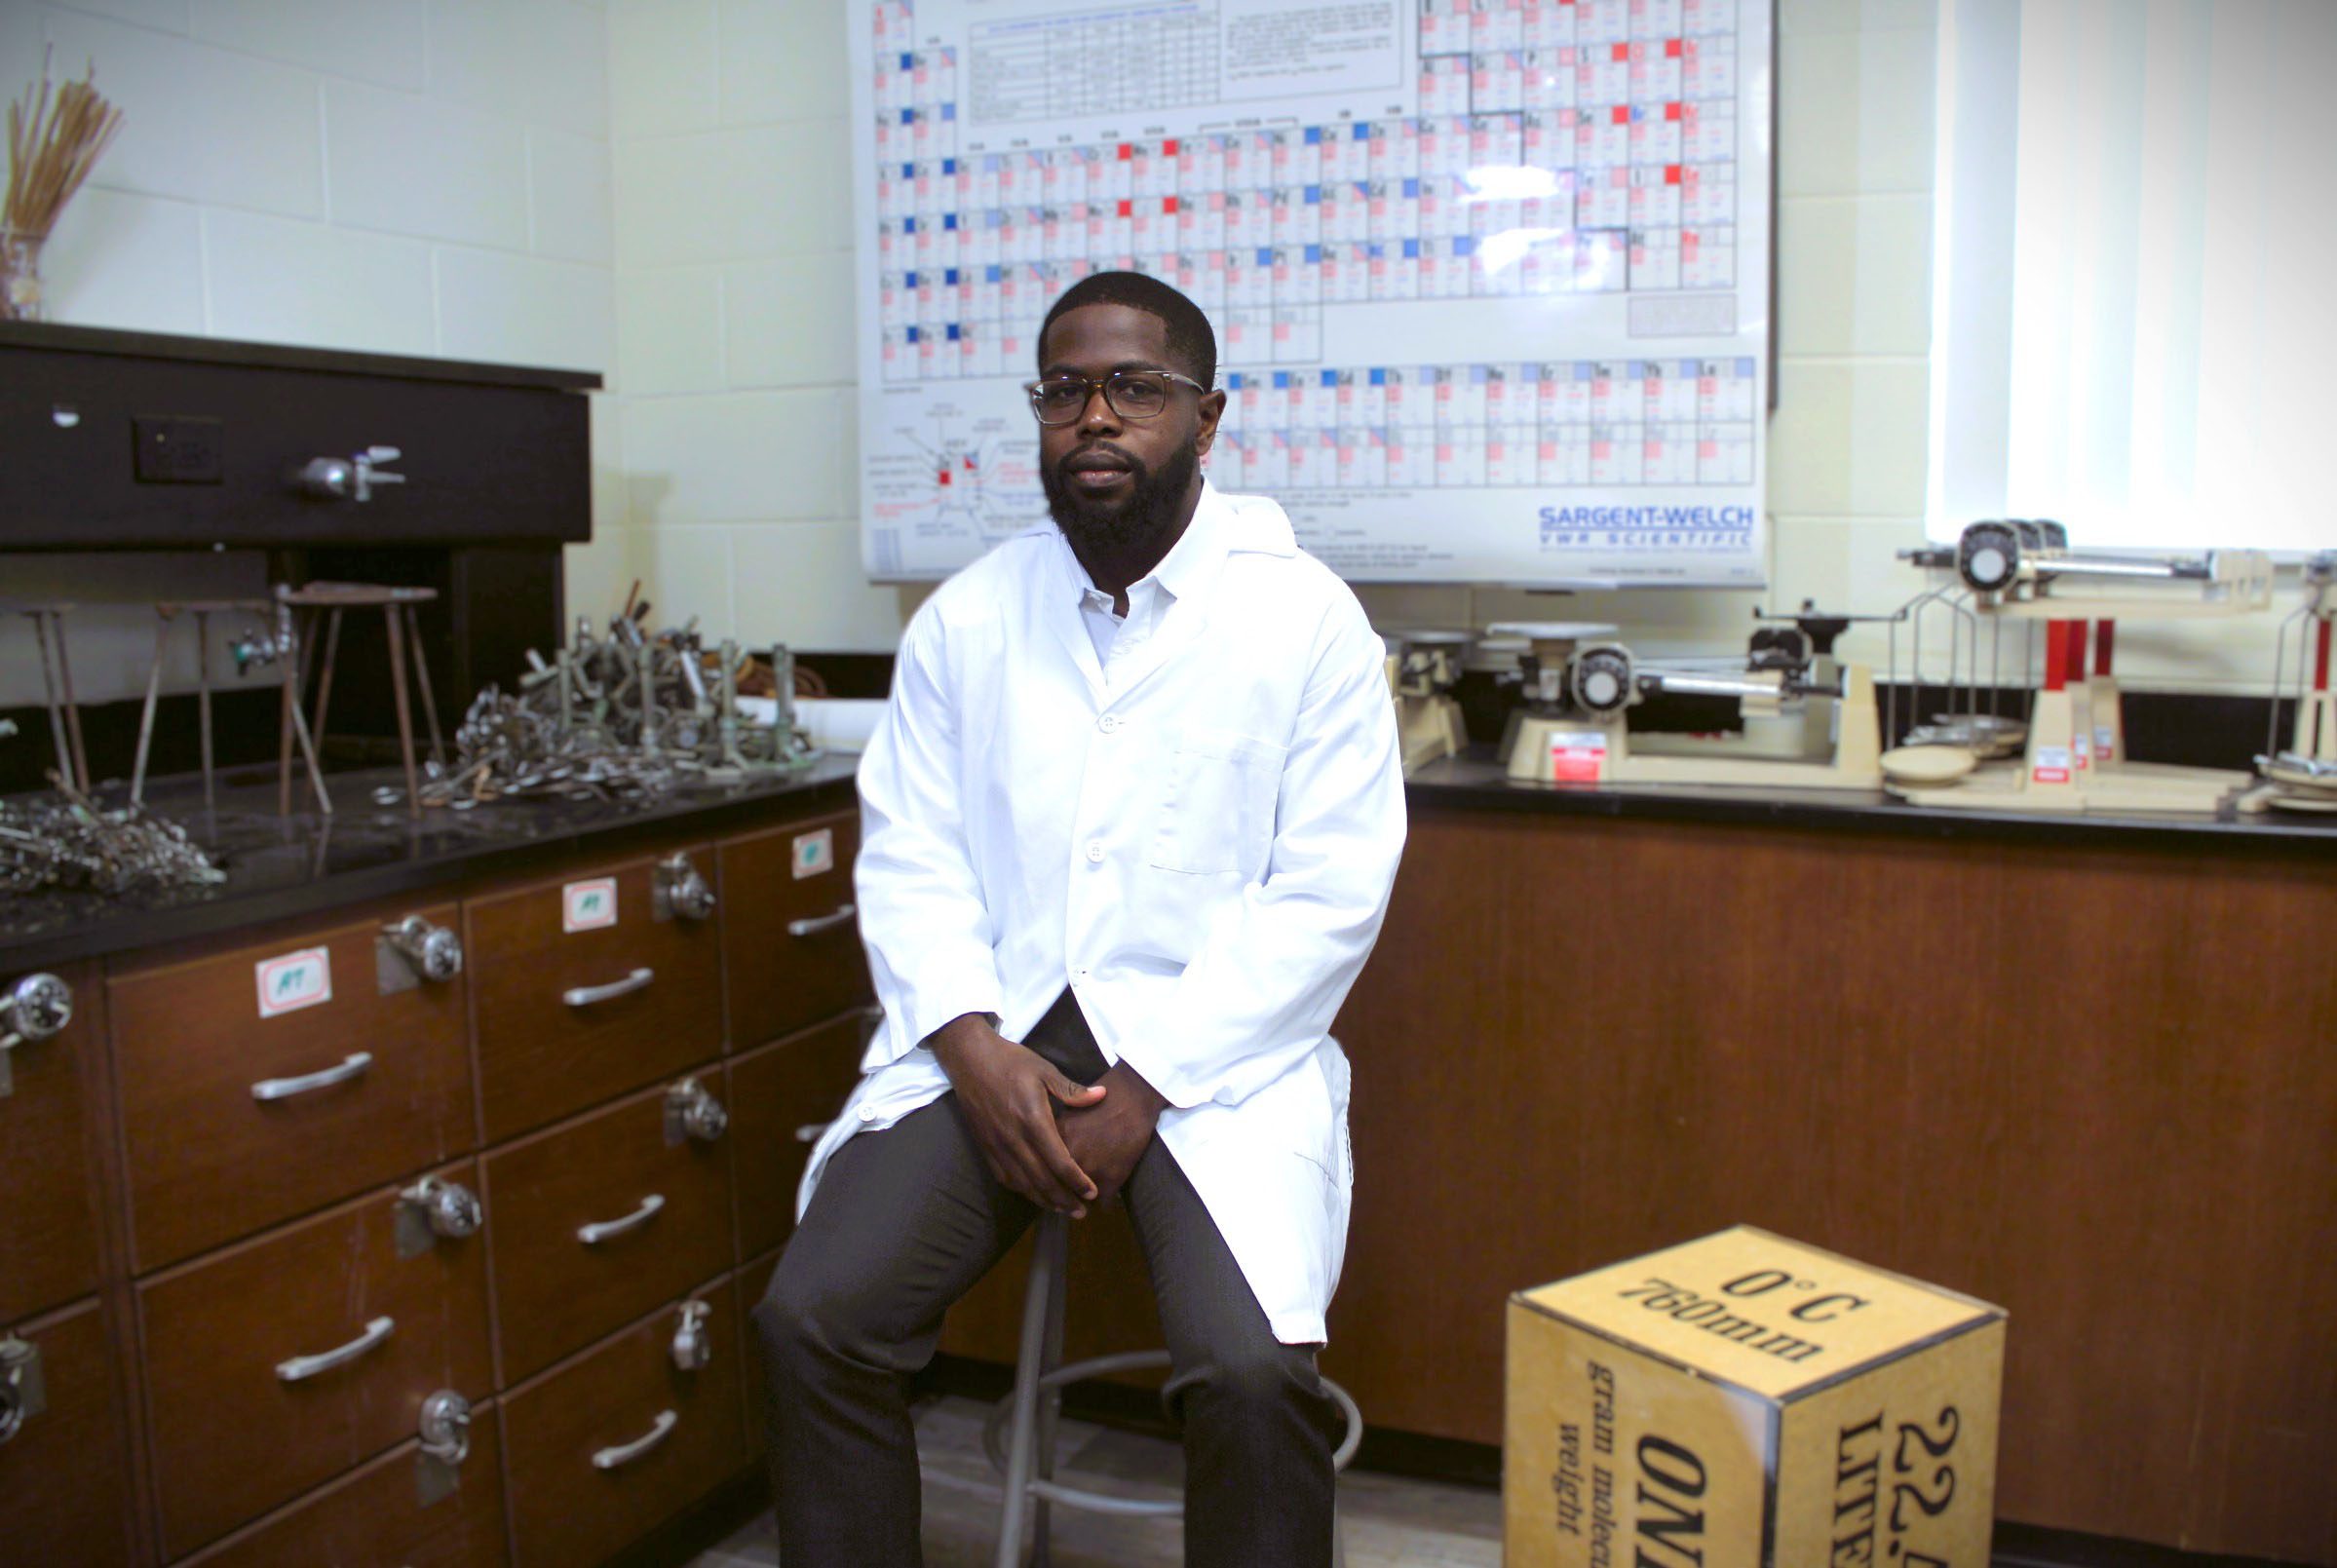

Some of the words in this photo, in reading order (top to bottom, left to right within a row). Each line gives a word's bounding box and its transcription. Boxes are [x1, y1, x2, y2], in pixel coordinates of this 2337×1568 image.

[1539, 506, 1753, 526] SARGENT-WELCH
[1540, 533, 1590, 545] VWR
[1606, 532, 1752, 546] SCIENTIFIC
[1617, 1277, 1823, 1363] 760mm
[1588, 1359, 1615, 1455] gram
[1552, 1423, 1585, 1536] weight
[1635, 1433, 1707, 1568] ON
[1888, 1405, 1959, 1568] 22.
